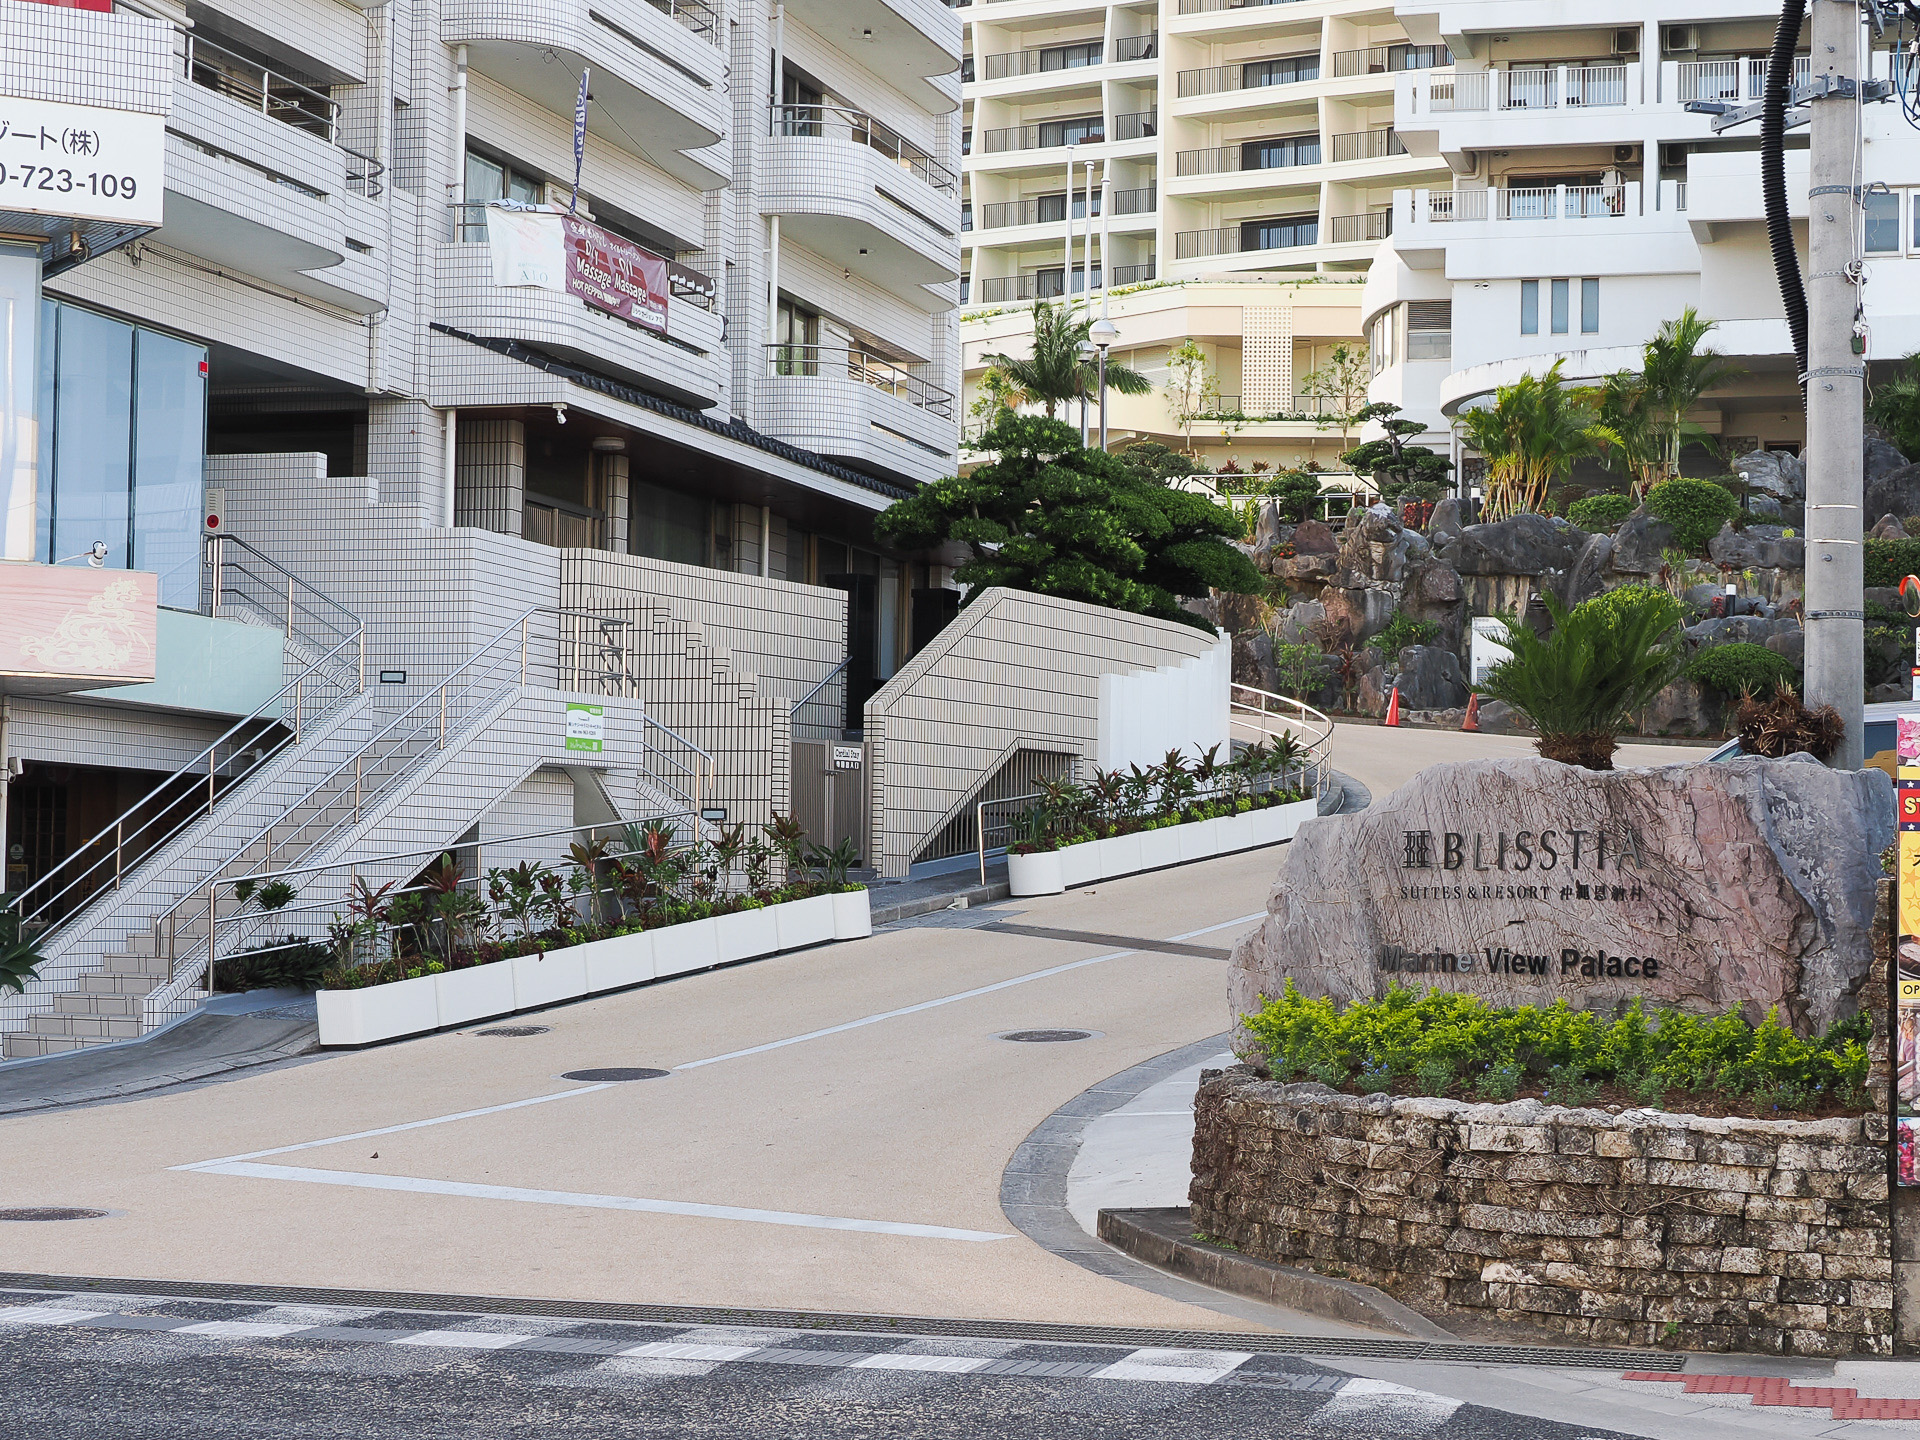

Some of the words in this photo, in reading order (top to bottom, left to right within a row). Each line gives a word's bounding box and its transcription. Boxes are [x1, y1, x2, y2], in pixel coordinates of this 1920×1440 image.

[576, 256, 612, 290] Massage
[614, 273, 647, 304] Massage
[1443, 829, 1642, 872] BLISSTIA
[1380, 944, 1473, 973] Marine
[1484, 947, 1548, 975] View
[1560, 948, 1659, 979] Palace
